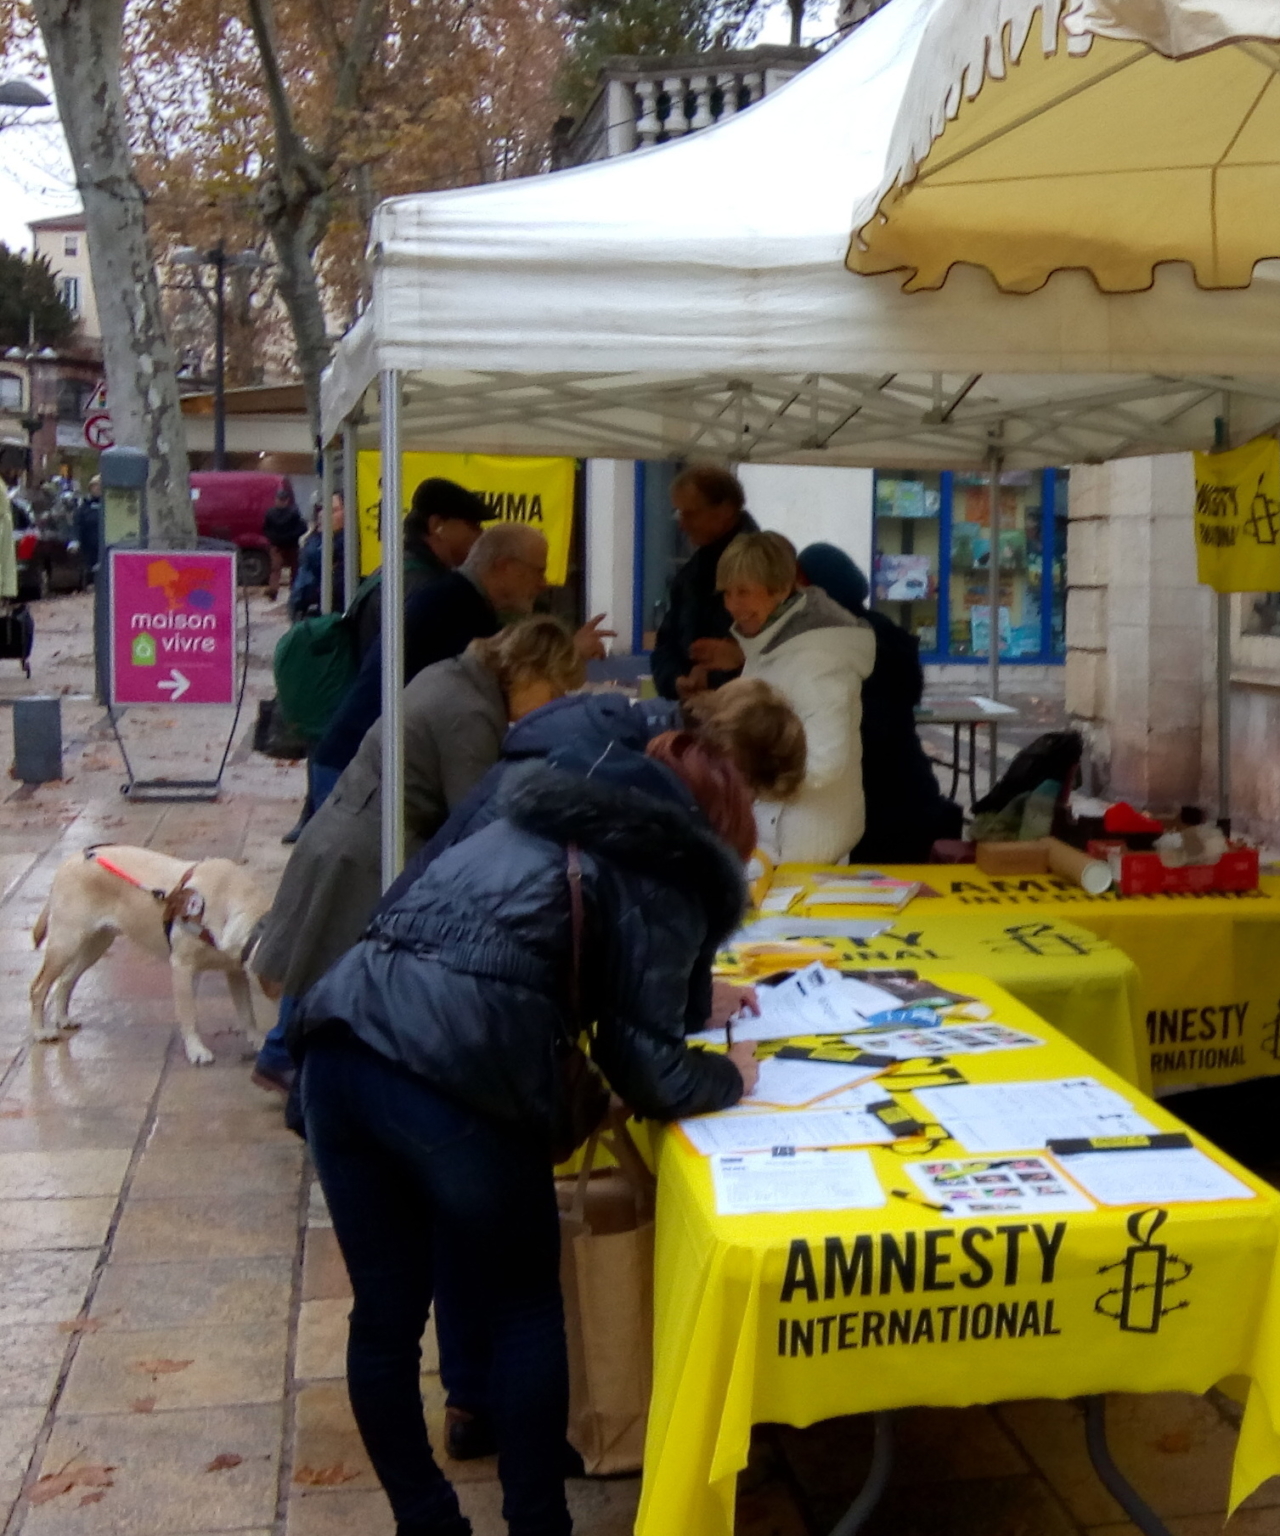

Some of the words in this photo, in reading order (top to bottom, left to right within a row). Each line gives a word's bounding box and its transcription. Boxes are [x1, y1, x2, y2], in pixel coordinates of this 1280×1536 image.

[131, 610, 216, 630] maison
[162, 632, 215, 653] vivre
[780, 1221, 1067, 1304] AMNESTY
[777, 1300, 1062, 1358] INTERNATIONAL
